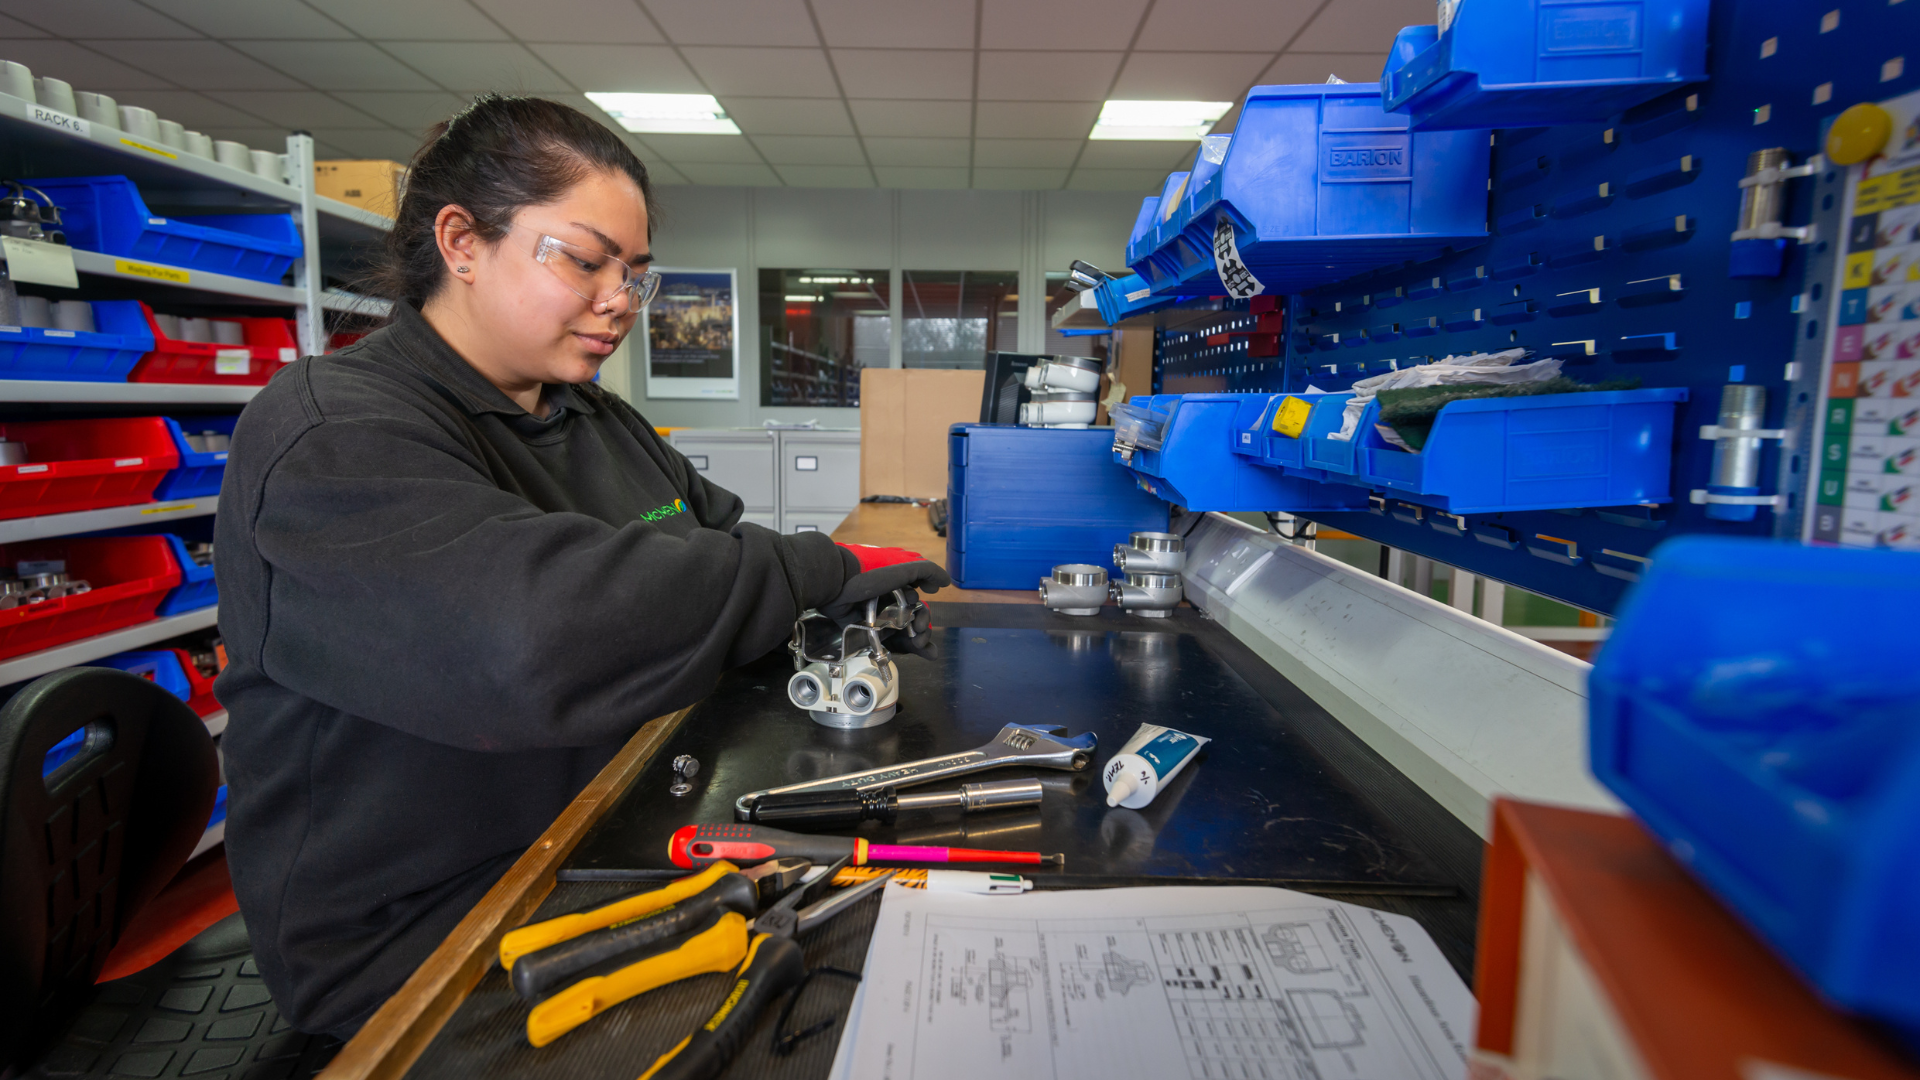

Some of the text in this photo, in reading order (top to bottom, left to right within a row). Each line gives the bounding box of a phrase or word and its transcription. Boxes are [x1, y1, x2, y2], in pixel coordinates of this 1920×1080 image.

[35, 109, 83, 132] RACK 6.
[1330, 145, 1403, 167] BARTON
[1827, 443, 1842, 461] S
[841, 767, 919, 788] HEAVY DUTY
